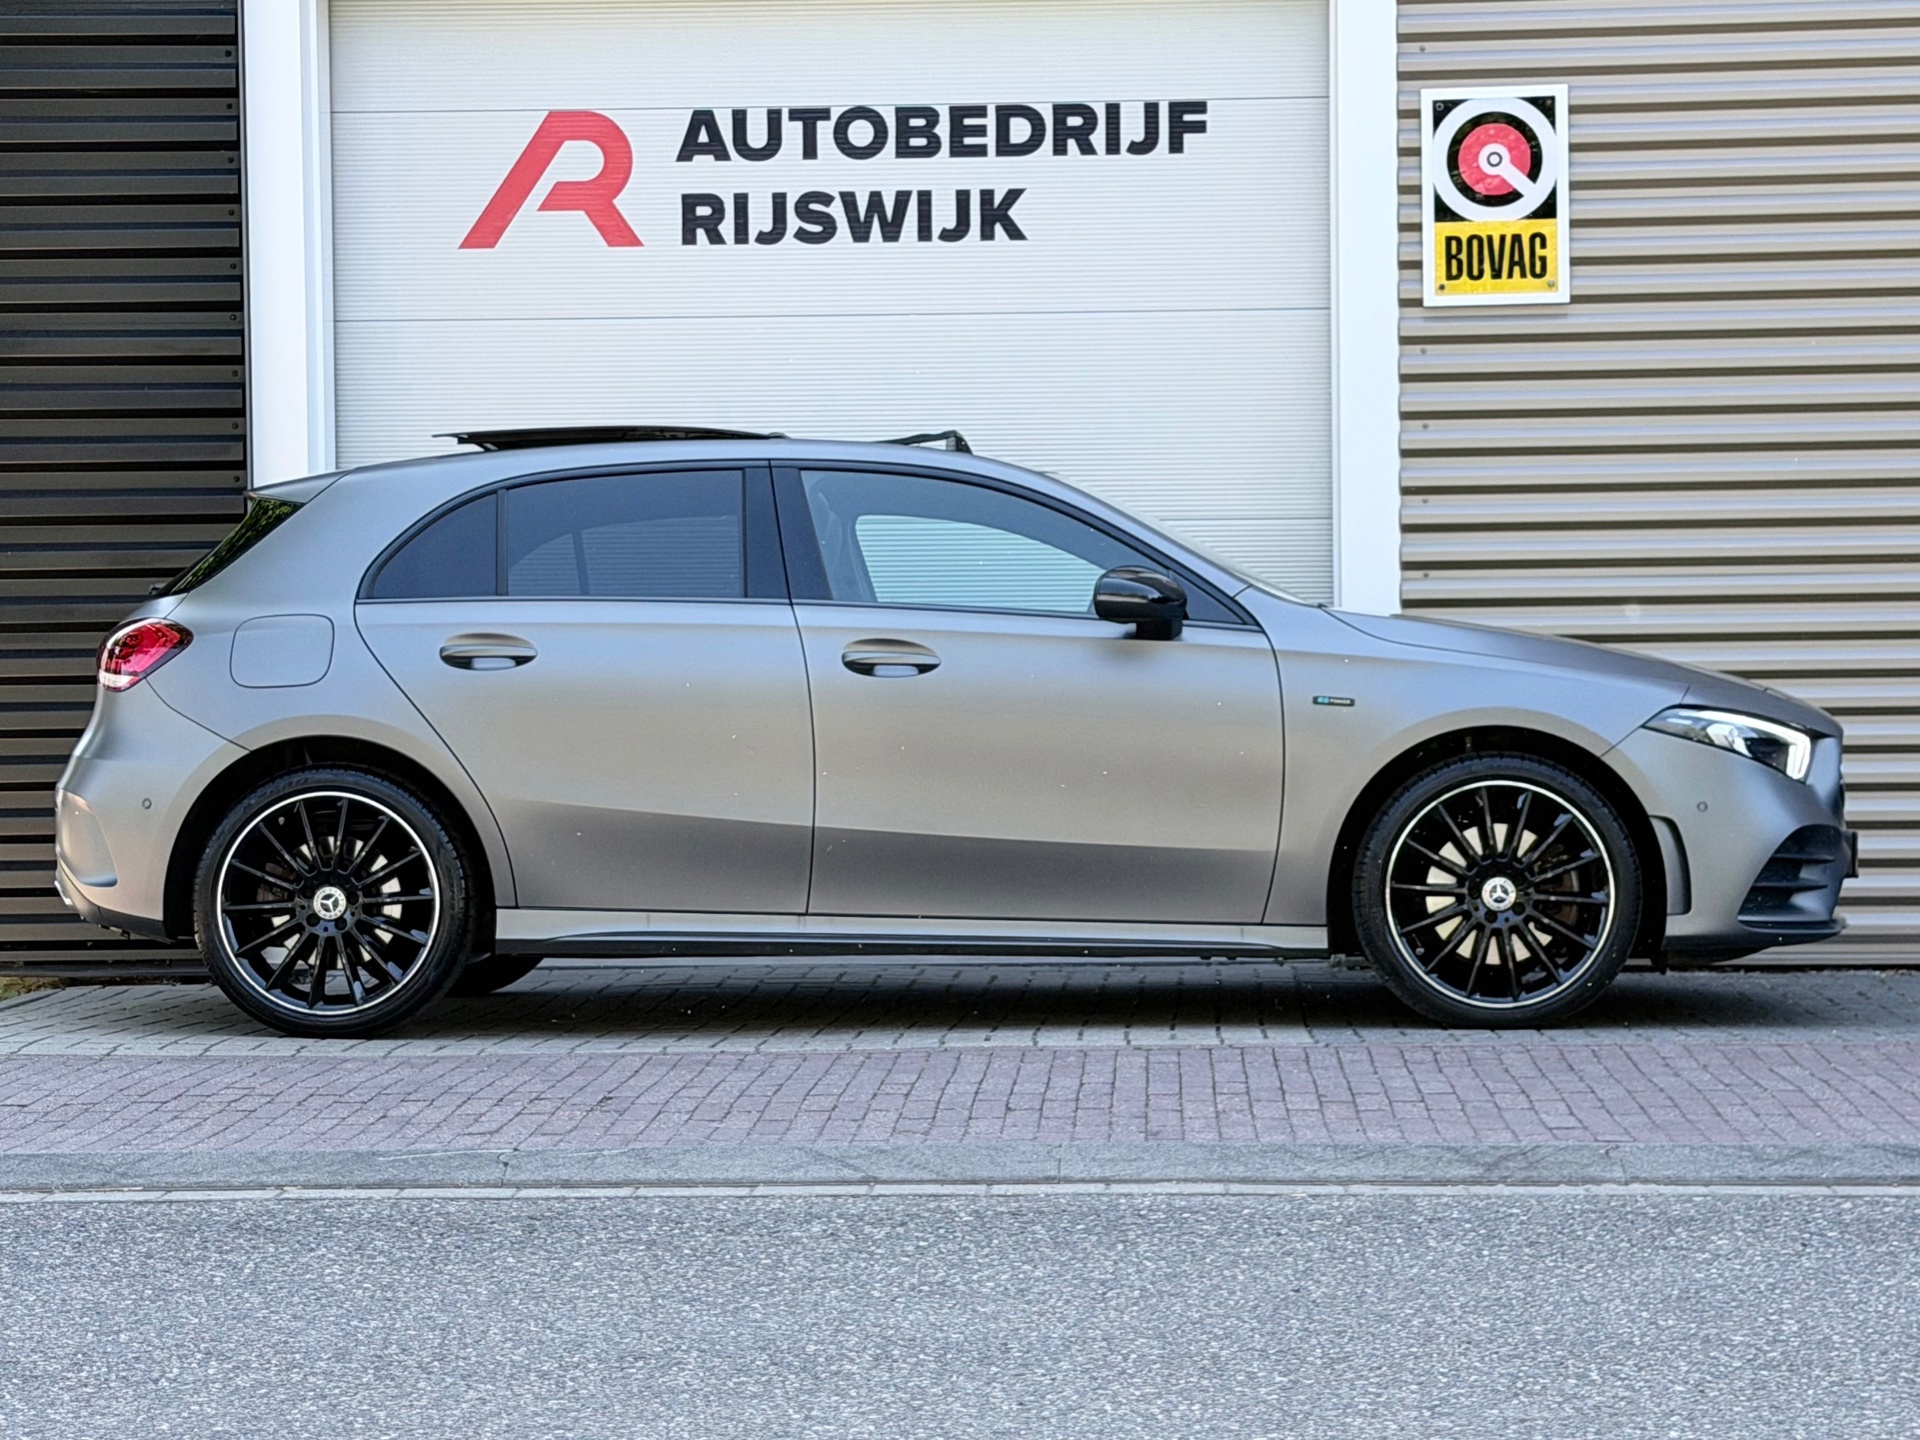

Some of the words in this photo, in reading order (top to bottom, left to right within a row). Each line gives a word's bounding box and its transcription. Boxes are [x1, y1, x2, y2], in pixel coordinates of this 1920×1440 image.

[676, 101, 1207, 162] AUTOBEDRIJF
[681, 188, 1028, 246] RIJSWIJK
[1445, 232, 1547, 281] BOVAG
